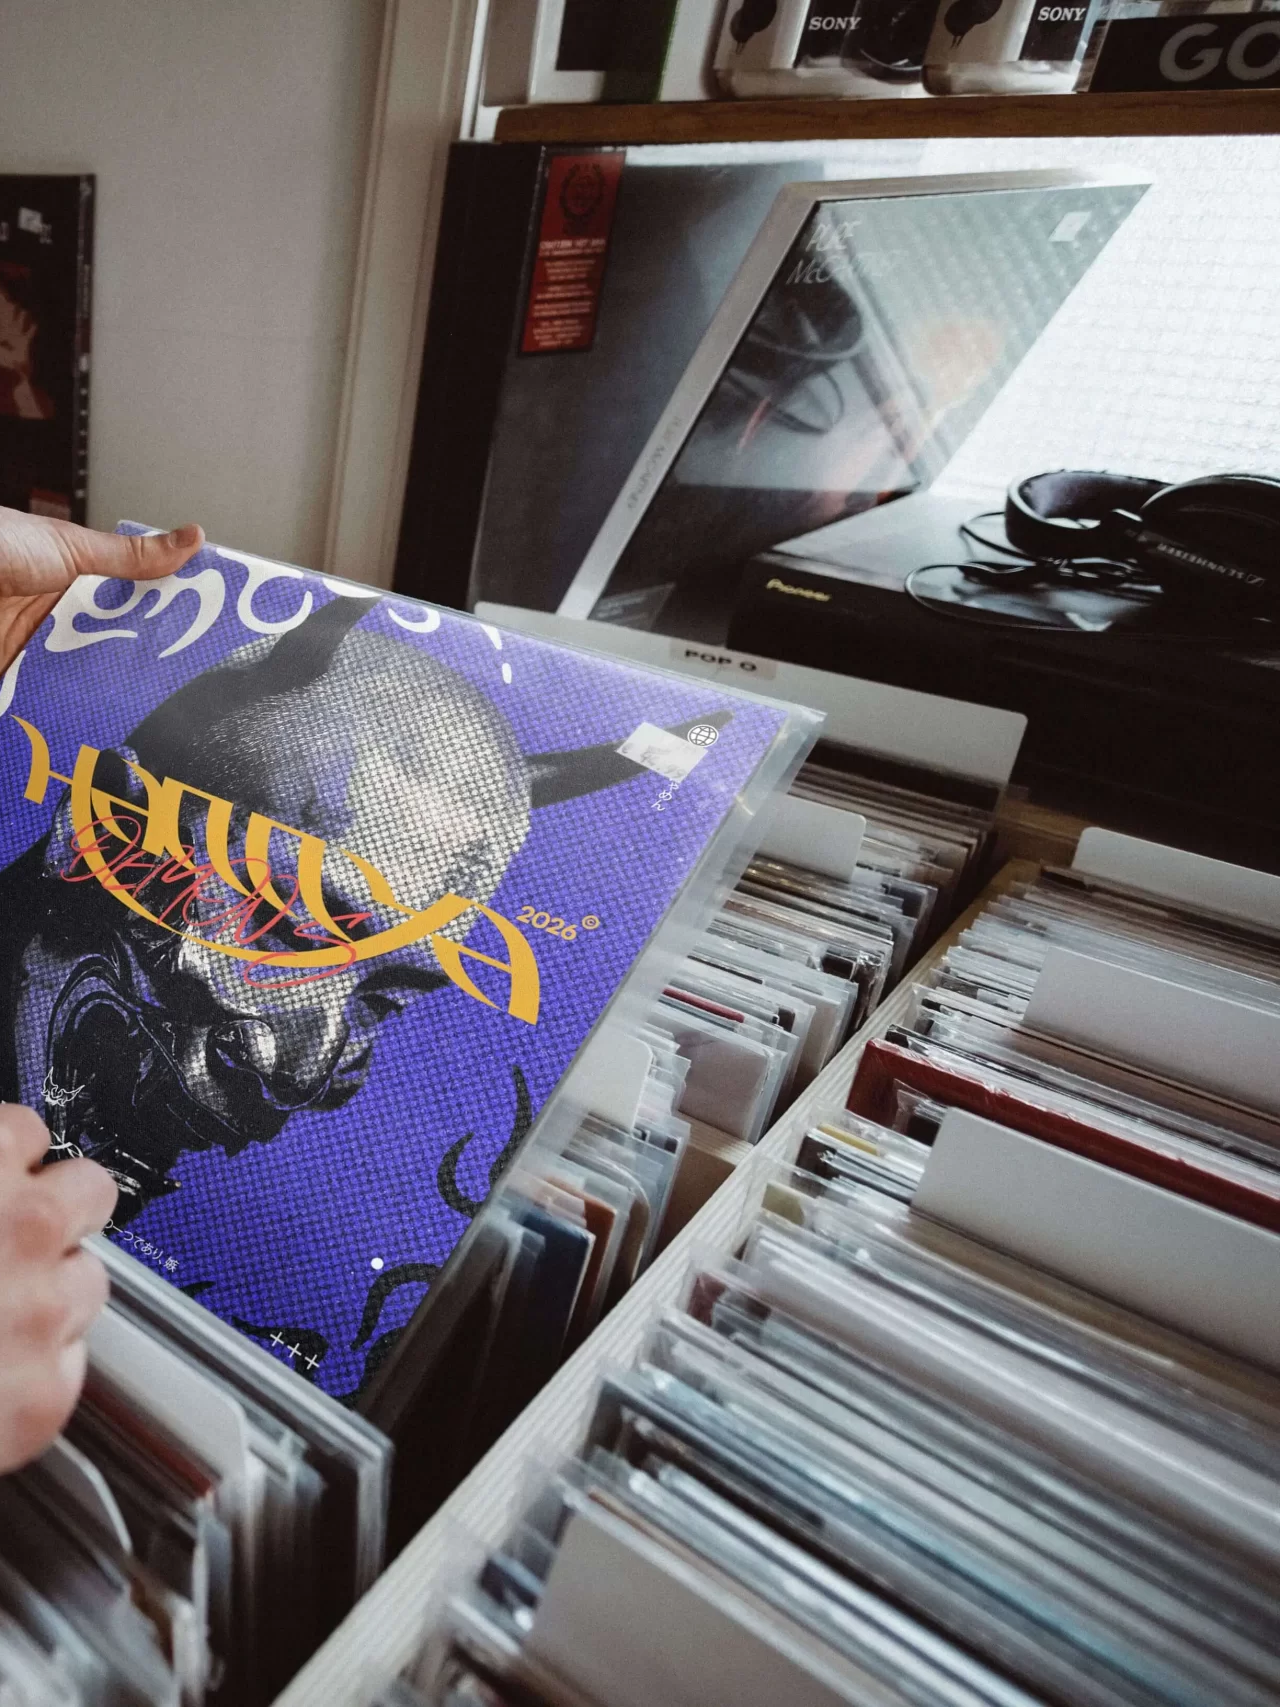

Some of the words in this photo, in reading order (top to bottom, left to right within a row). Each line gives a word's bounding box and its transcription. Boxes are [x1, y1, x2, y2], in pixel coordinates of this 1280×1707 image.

[808, 16, 861, 31] SONY
[1037, 6, 1086, 22] SONY
[685, 649, 732, 665] POP
[739, 661, 757, 672] O
[516, 905, 578, 941] 2026
